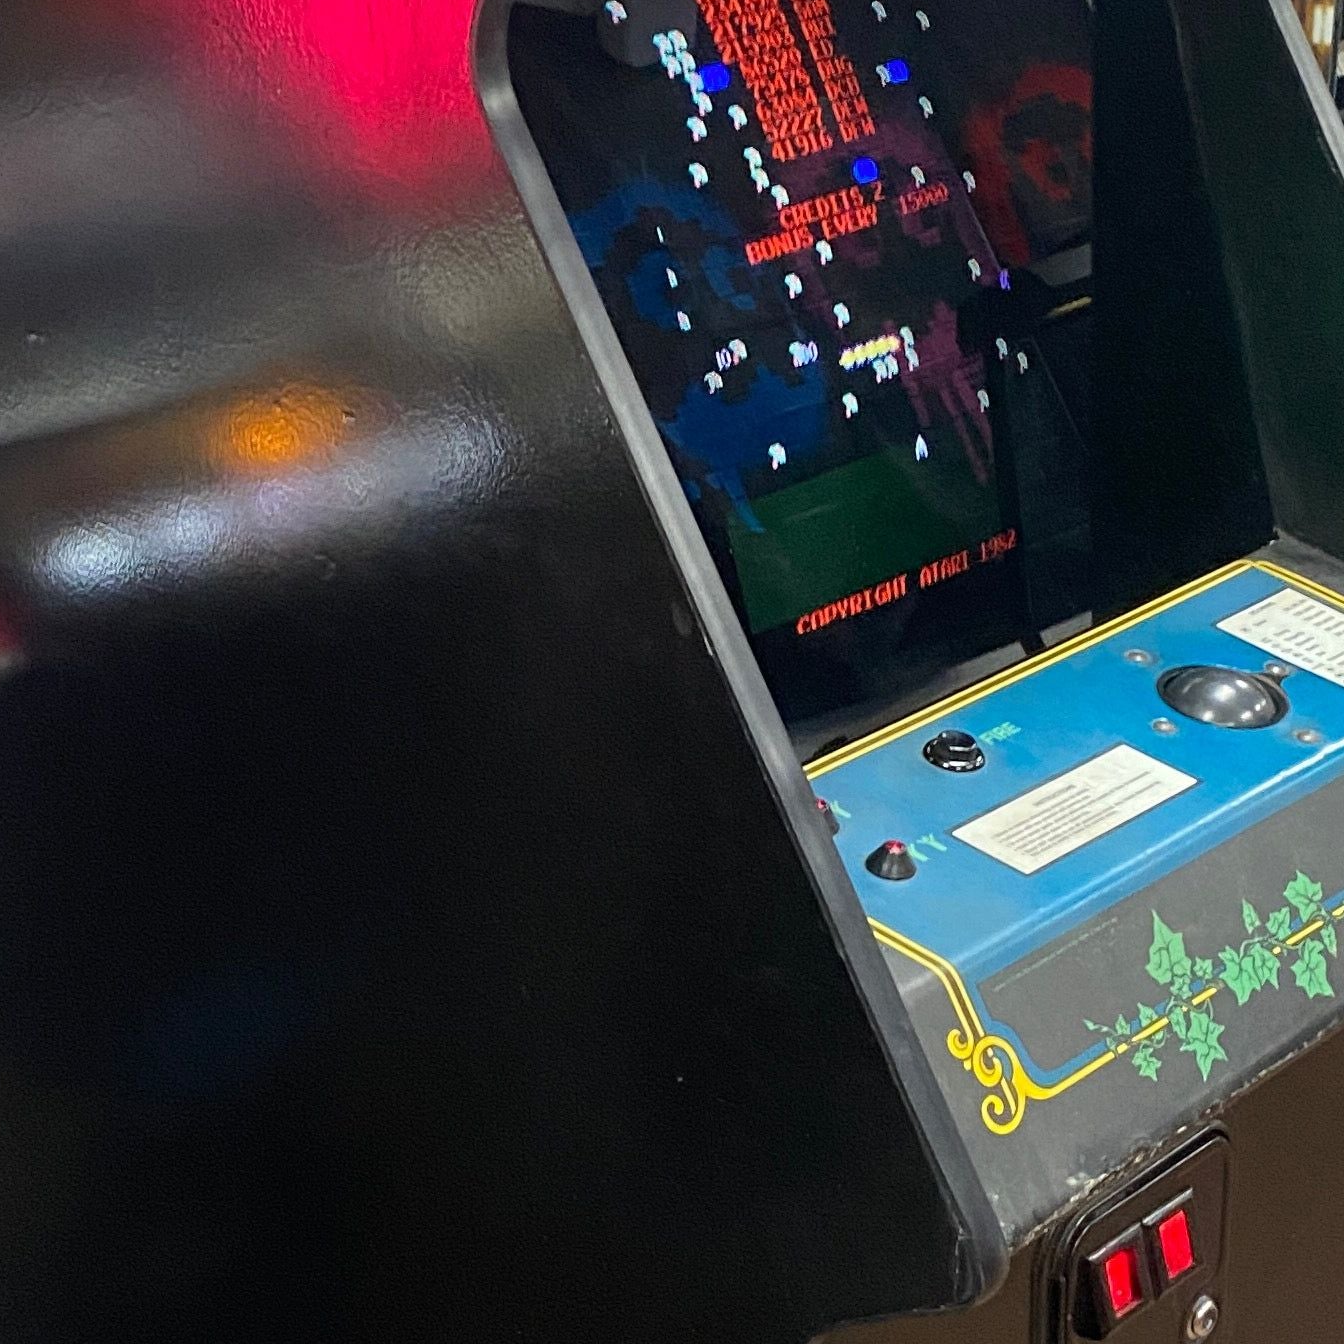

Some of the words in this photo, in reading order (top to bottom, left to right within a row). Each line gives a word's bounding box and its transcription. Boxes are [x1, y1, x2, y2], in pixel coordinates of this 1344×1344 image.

[767, 126, 836, 162] 41916
[779, 185, 864, 229] CREDITS
[873, 180, 886, 203] 2
[744, 227, 814, 267] BONUS
[821, 203, 878, 241] EVERY
[795, 573, 907, 635] COPYRIGHT
[919, 549, 970, 589] ATARI
